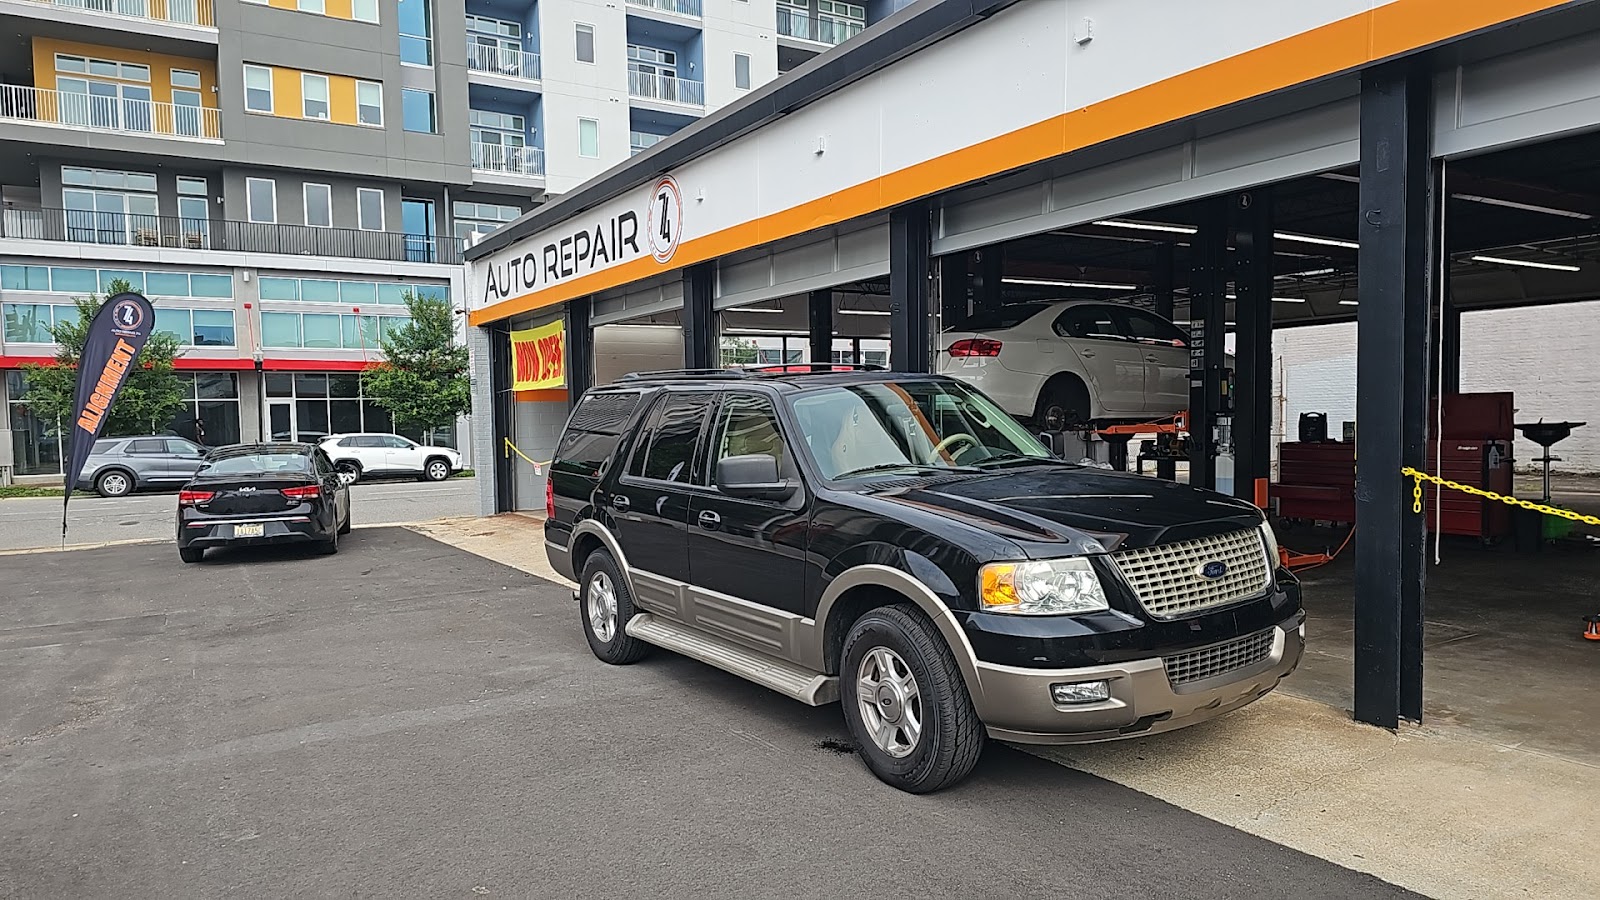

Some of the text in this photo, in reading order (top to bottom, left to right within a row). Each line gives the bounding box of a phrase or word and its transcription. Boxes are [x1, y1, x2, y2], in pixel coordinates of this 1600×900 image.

[484, 252, 537, 303] AUTO
[544, 210, 640, 284] REPAIR
[77, 337, 136, 435] ALIGNMENT
[514, 340, 540, 382] NOW
[1207, 563, 1222, 576] Ford
